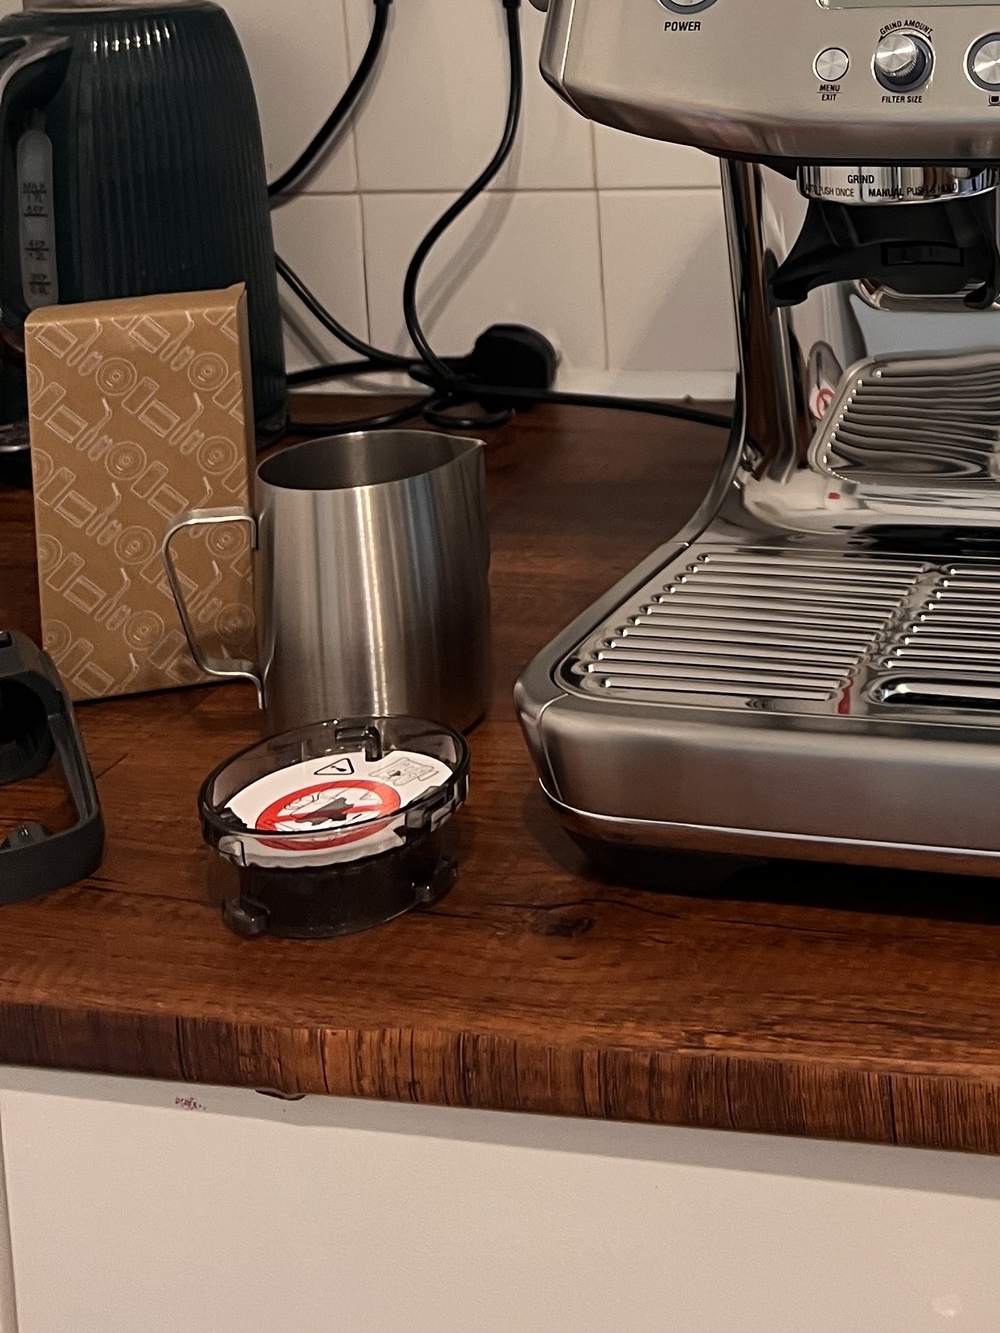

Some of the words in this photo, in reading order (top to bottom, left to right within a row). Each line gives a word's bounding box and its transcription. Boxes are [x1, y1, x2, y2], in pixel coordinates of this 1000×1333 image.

[664, 21, 702, 32] POWER
[880, 20, 902, 35] GRIND
[903, 19, 933, 34] AMOUNT
[819, 84, 841, 92] MENU
[821, 93, 838, 102] EXIT
[881, 95, 906, 104] FILTER
[906, 95, 923, 104] SIZE
[847, 174, 875, 184] GRIND
[836, 187, 855, 198] ONCE
[868, 186, 904, 198] MANUAL
[906, 184, 929, 196] PUSH
